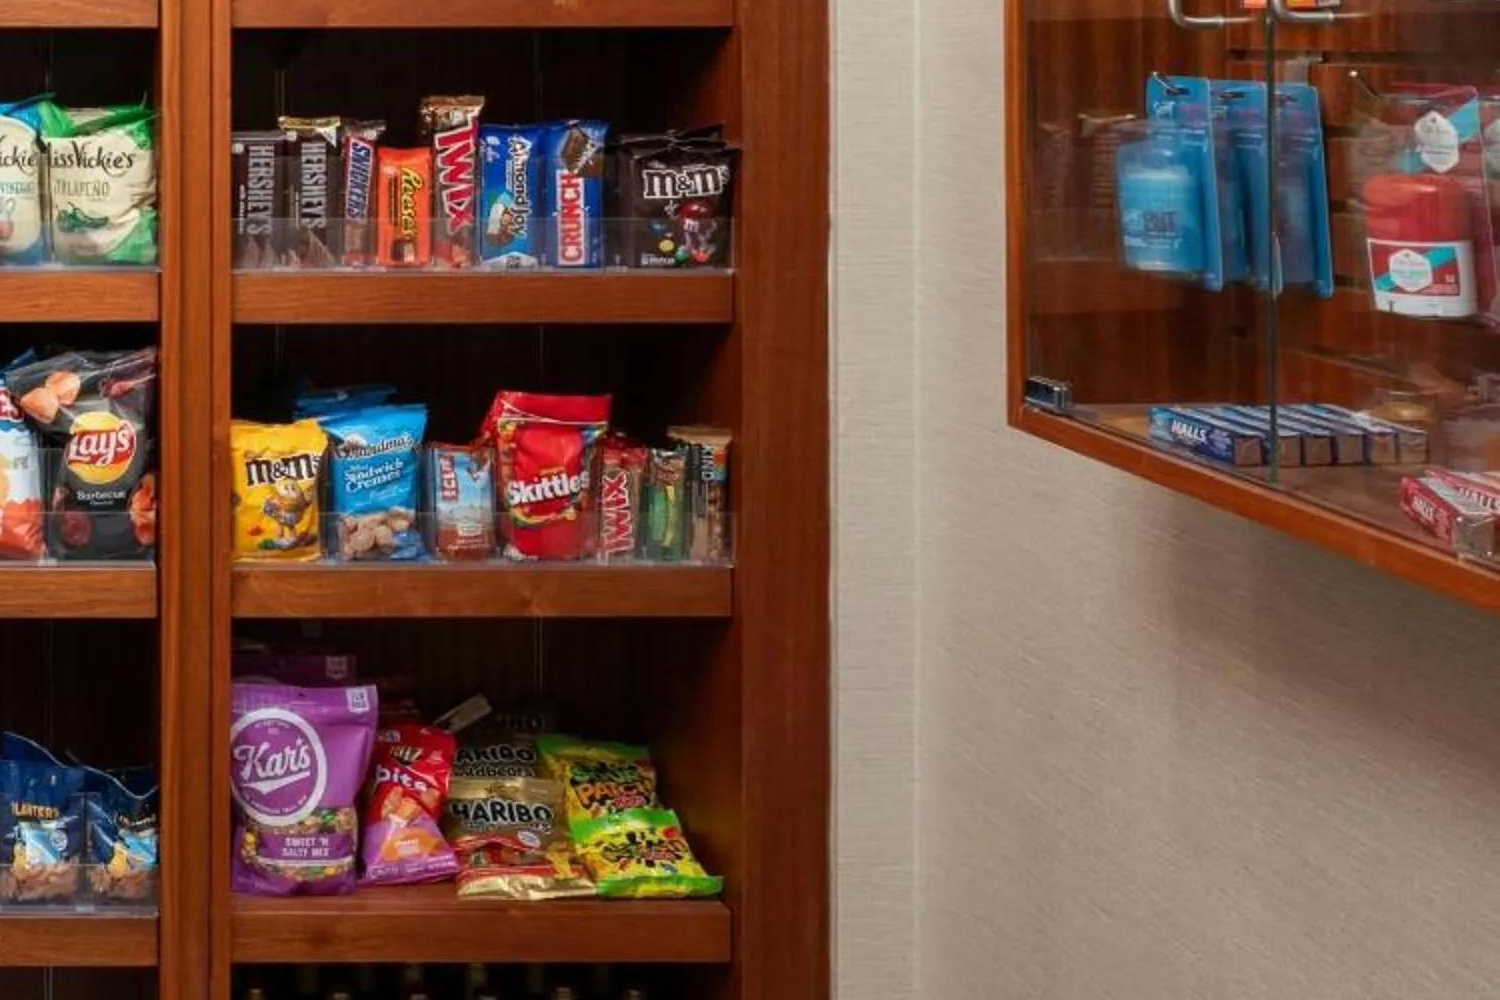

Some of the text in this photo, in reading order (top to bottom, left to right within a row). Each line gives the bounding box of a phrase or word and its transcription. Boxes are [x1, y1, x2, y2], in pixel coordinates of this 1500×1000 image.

[48, 140, 74, 169] iss
[434, 112, 480, 235] TWIX
[346, 141, 373, 218] SNICKERS
[559, 171, 583, 263] CRUNCH
[76, 490, 126, 501] Barbecue
[506, 471, 591, 505] Skittles
[601, 469, 635, 560] TWIX
[233, 738, 311, 780] Kar's
[455, 744, 537, 764] ARIBO
